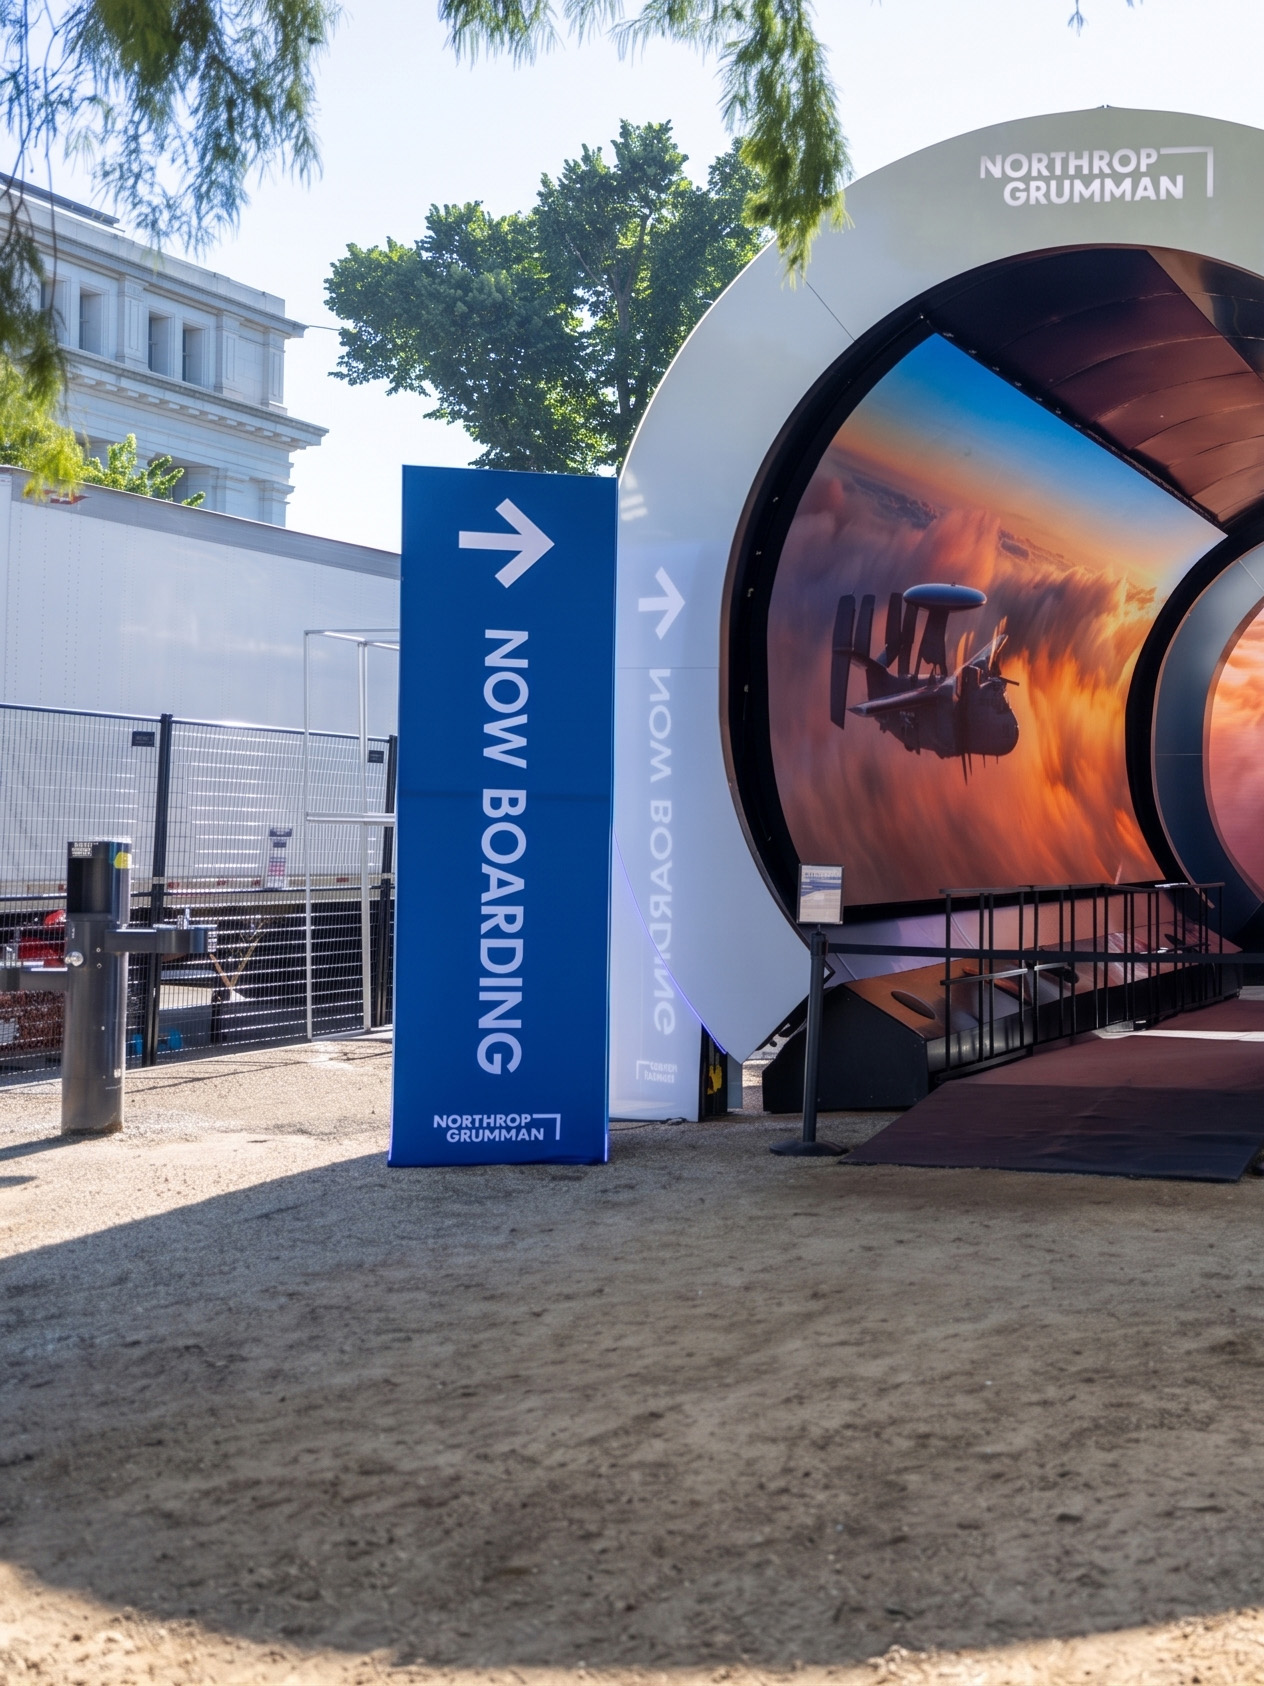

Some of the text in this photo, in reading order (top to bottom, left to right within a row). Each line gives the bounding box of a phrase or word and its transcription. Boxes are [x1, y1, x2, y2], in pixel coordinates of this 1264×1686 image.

[980, 148, 1158, 178] NORTHROP
[1003, 175, 1184, 207] GRUMMAN
[476, 629, 529, 1075] NOW BOARDING
[433, 1113, 532, 1128] NORTHROP
[446, 1127, 545, 1143] GRUMMAN
